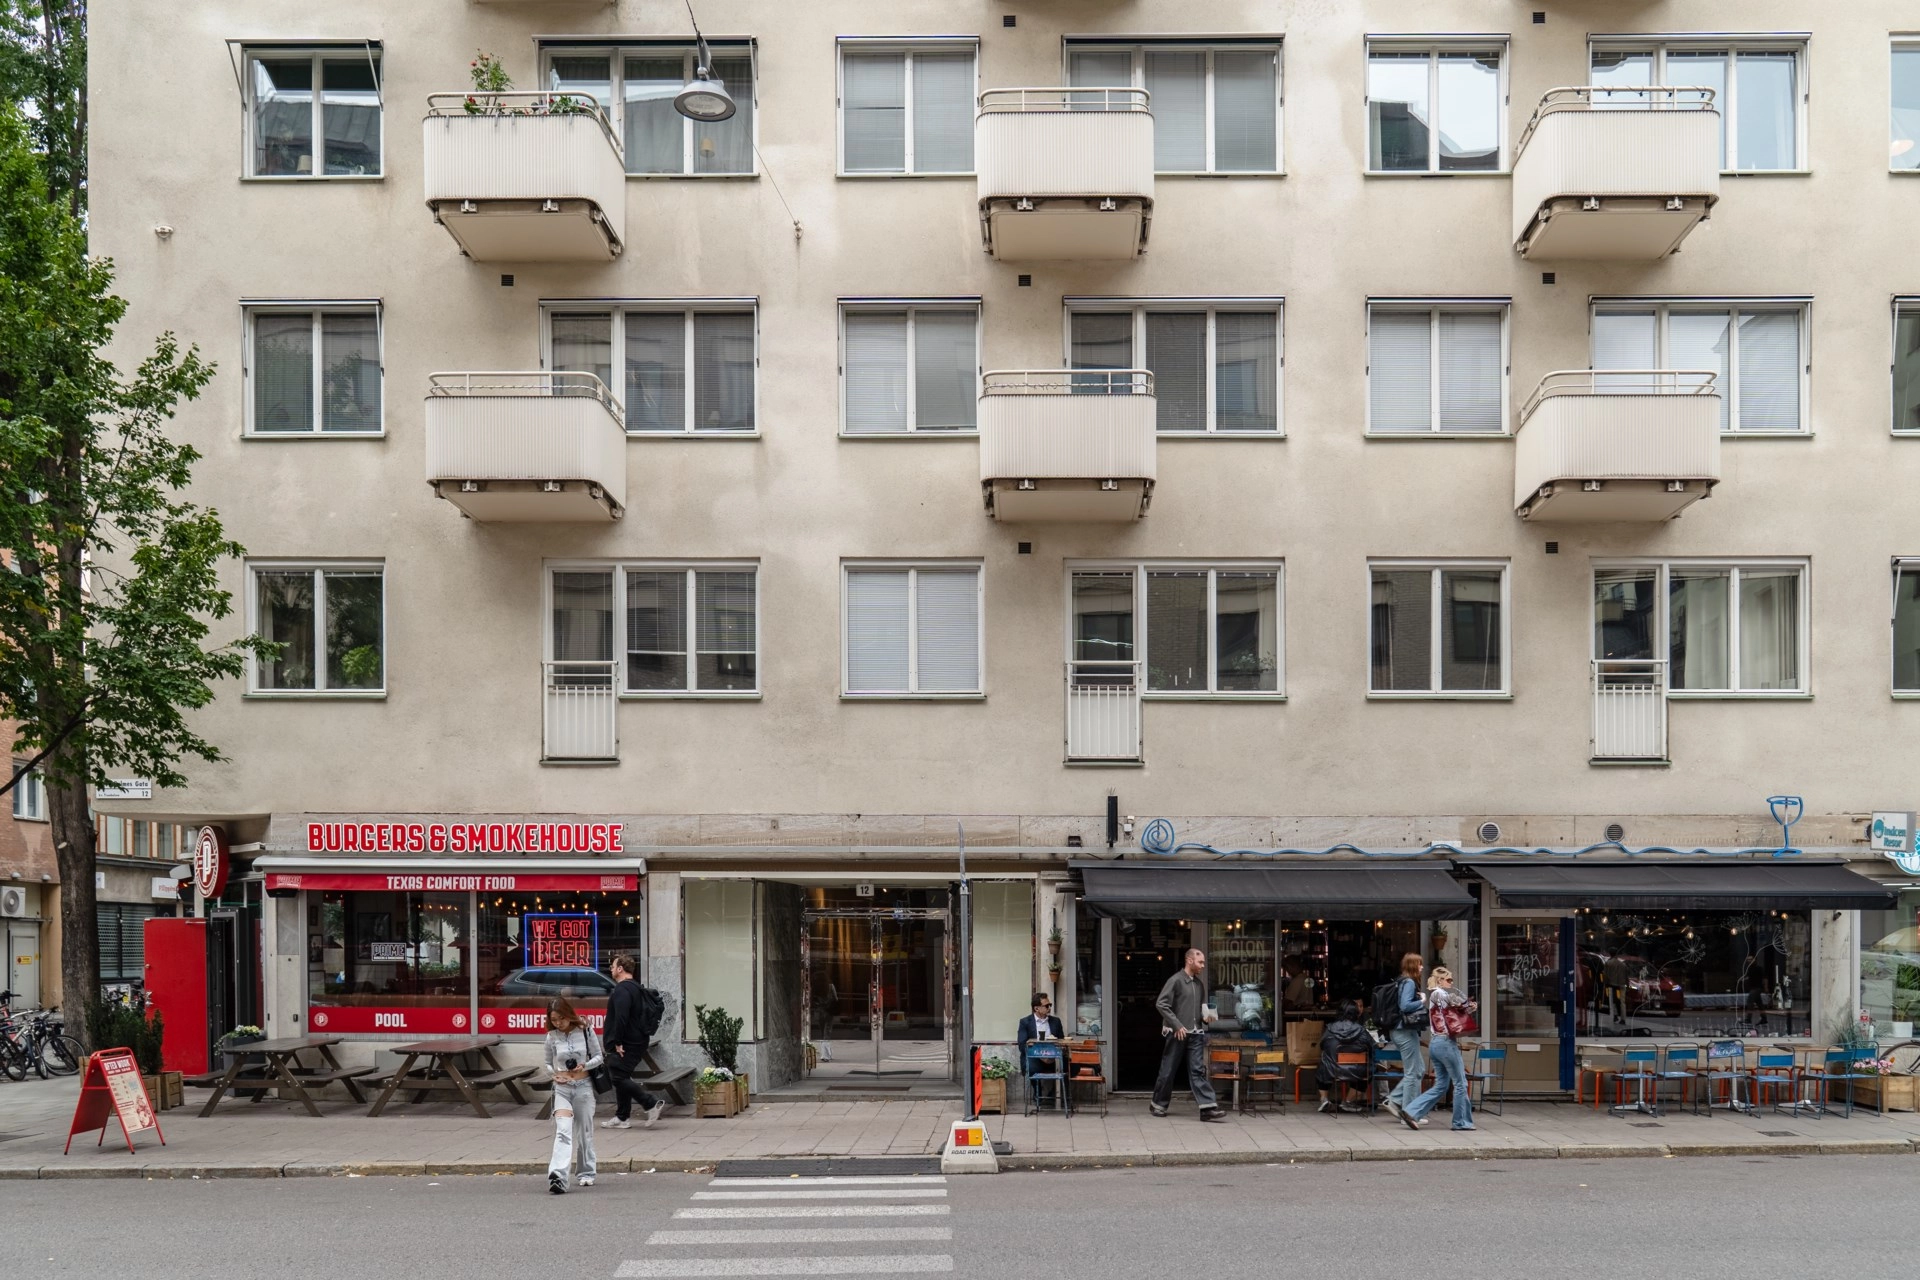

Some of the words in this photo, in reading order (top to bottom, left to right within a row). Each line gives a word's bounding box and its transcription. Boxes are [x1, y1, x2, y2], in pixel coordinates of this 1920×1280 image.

[308, 823, 426, 852] BURGERS
[428, 823, 448, 852] &
[450, 823, 624, 853] SMOKEHOUSE
[387, 876, 423, 890] TEXAS
[426, 876, 482, 890] COMFORT
[485, 876, 516, 890] FOOD
[860, 885, 870, 895] 12
[532, 920, 557, 938] WE
[560, 920, 591, 938] GOT
[533, 940, 590, 966] BEER
[1513, 954, 1541, 971] BAR
[1218, 963, 1265, 986] DINGUE
[1507, 965, 1550, 983] INGRID
[375, 1013, 407, 1027] POOL
